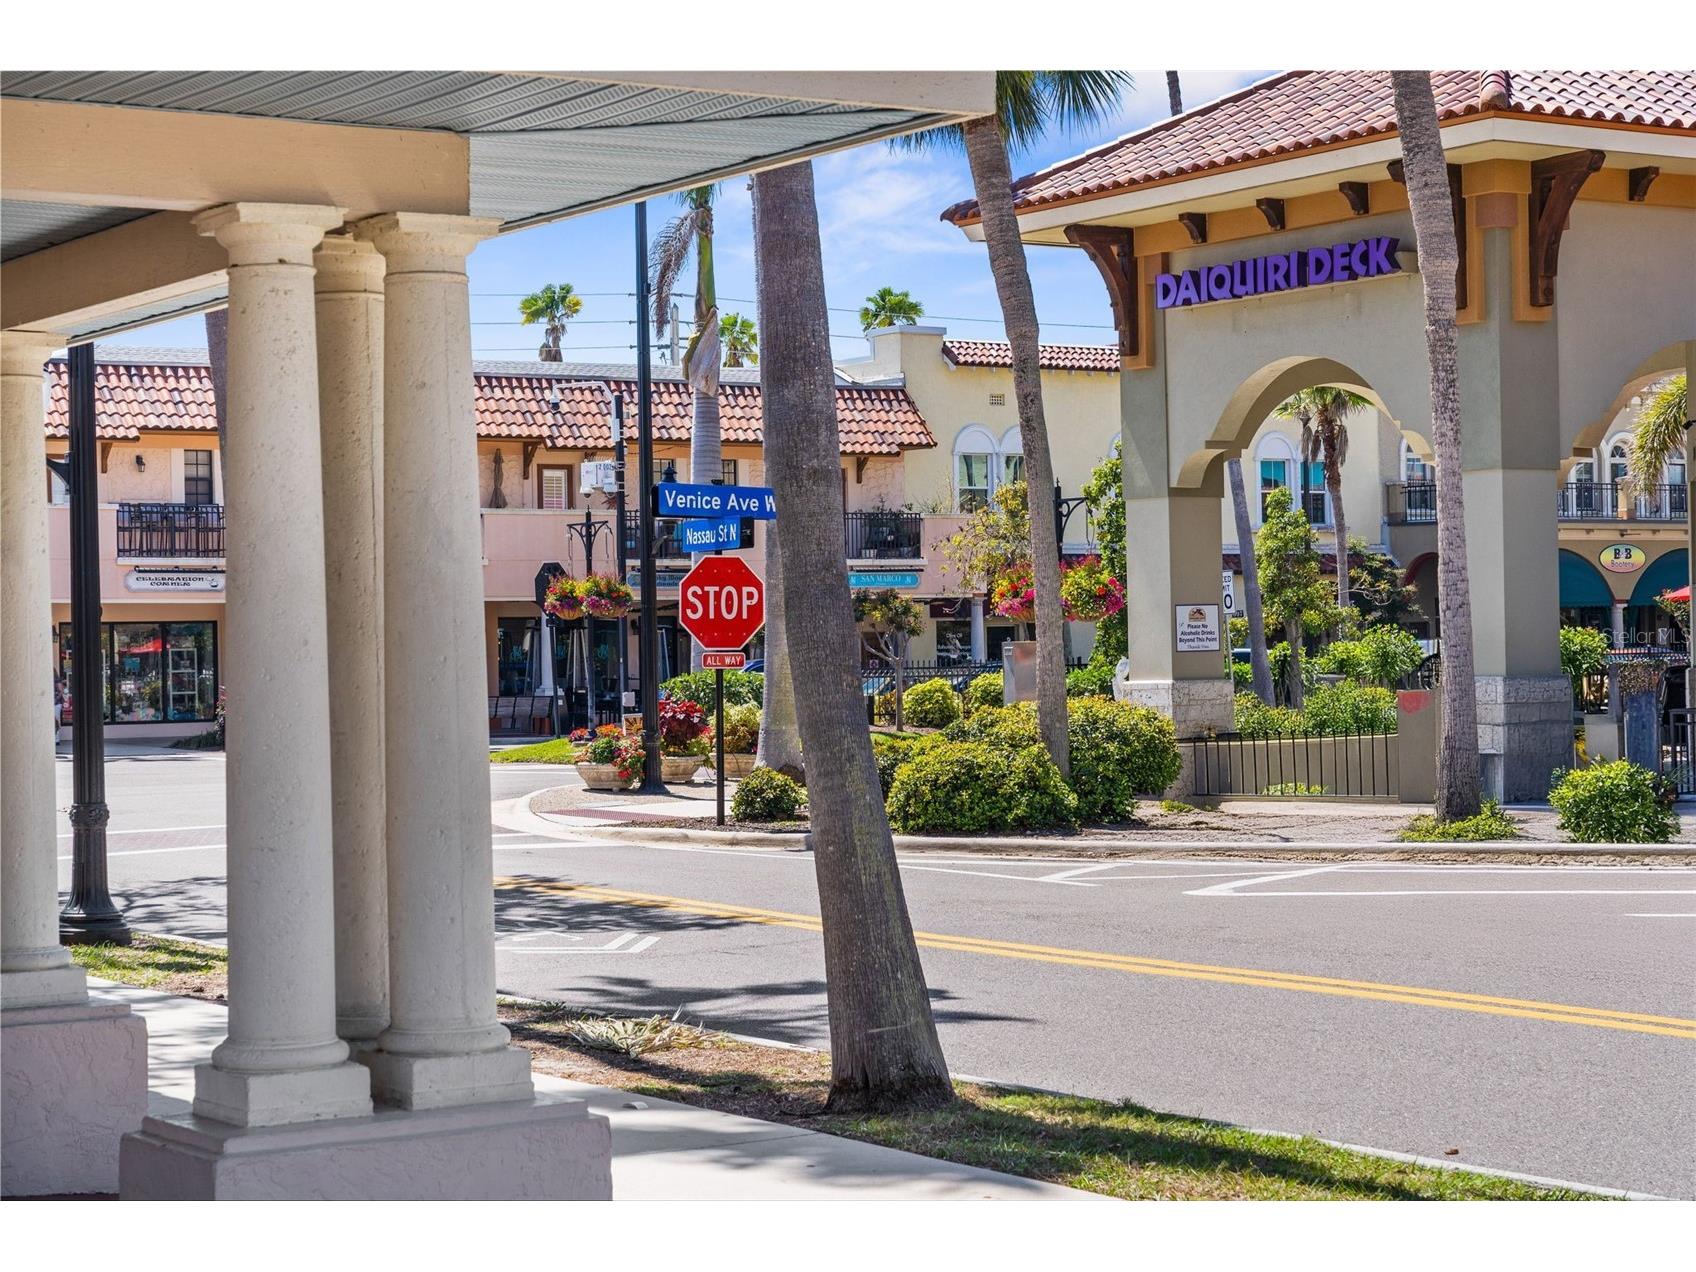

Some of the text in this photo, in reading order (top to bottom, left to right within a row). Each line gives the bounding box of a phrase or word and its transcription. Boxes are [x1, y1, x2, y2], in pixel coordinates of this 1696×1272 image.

[1155, 236, 1397, 309] DAIQUIRI DECK
[665, 490, 777, 512] Venice Ave W
[686, 524, 737, 545] Nassau St N
[1610, 560, 1634, 568] Bootery
[861, 575, 902, 583] SAN MARCO
[686, 586, 759, 620] STOP
[1224, 594, 1233, 609] 0
[706, 656, 742, 666] ALL WAY
